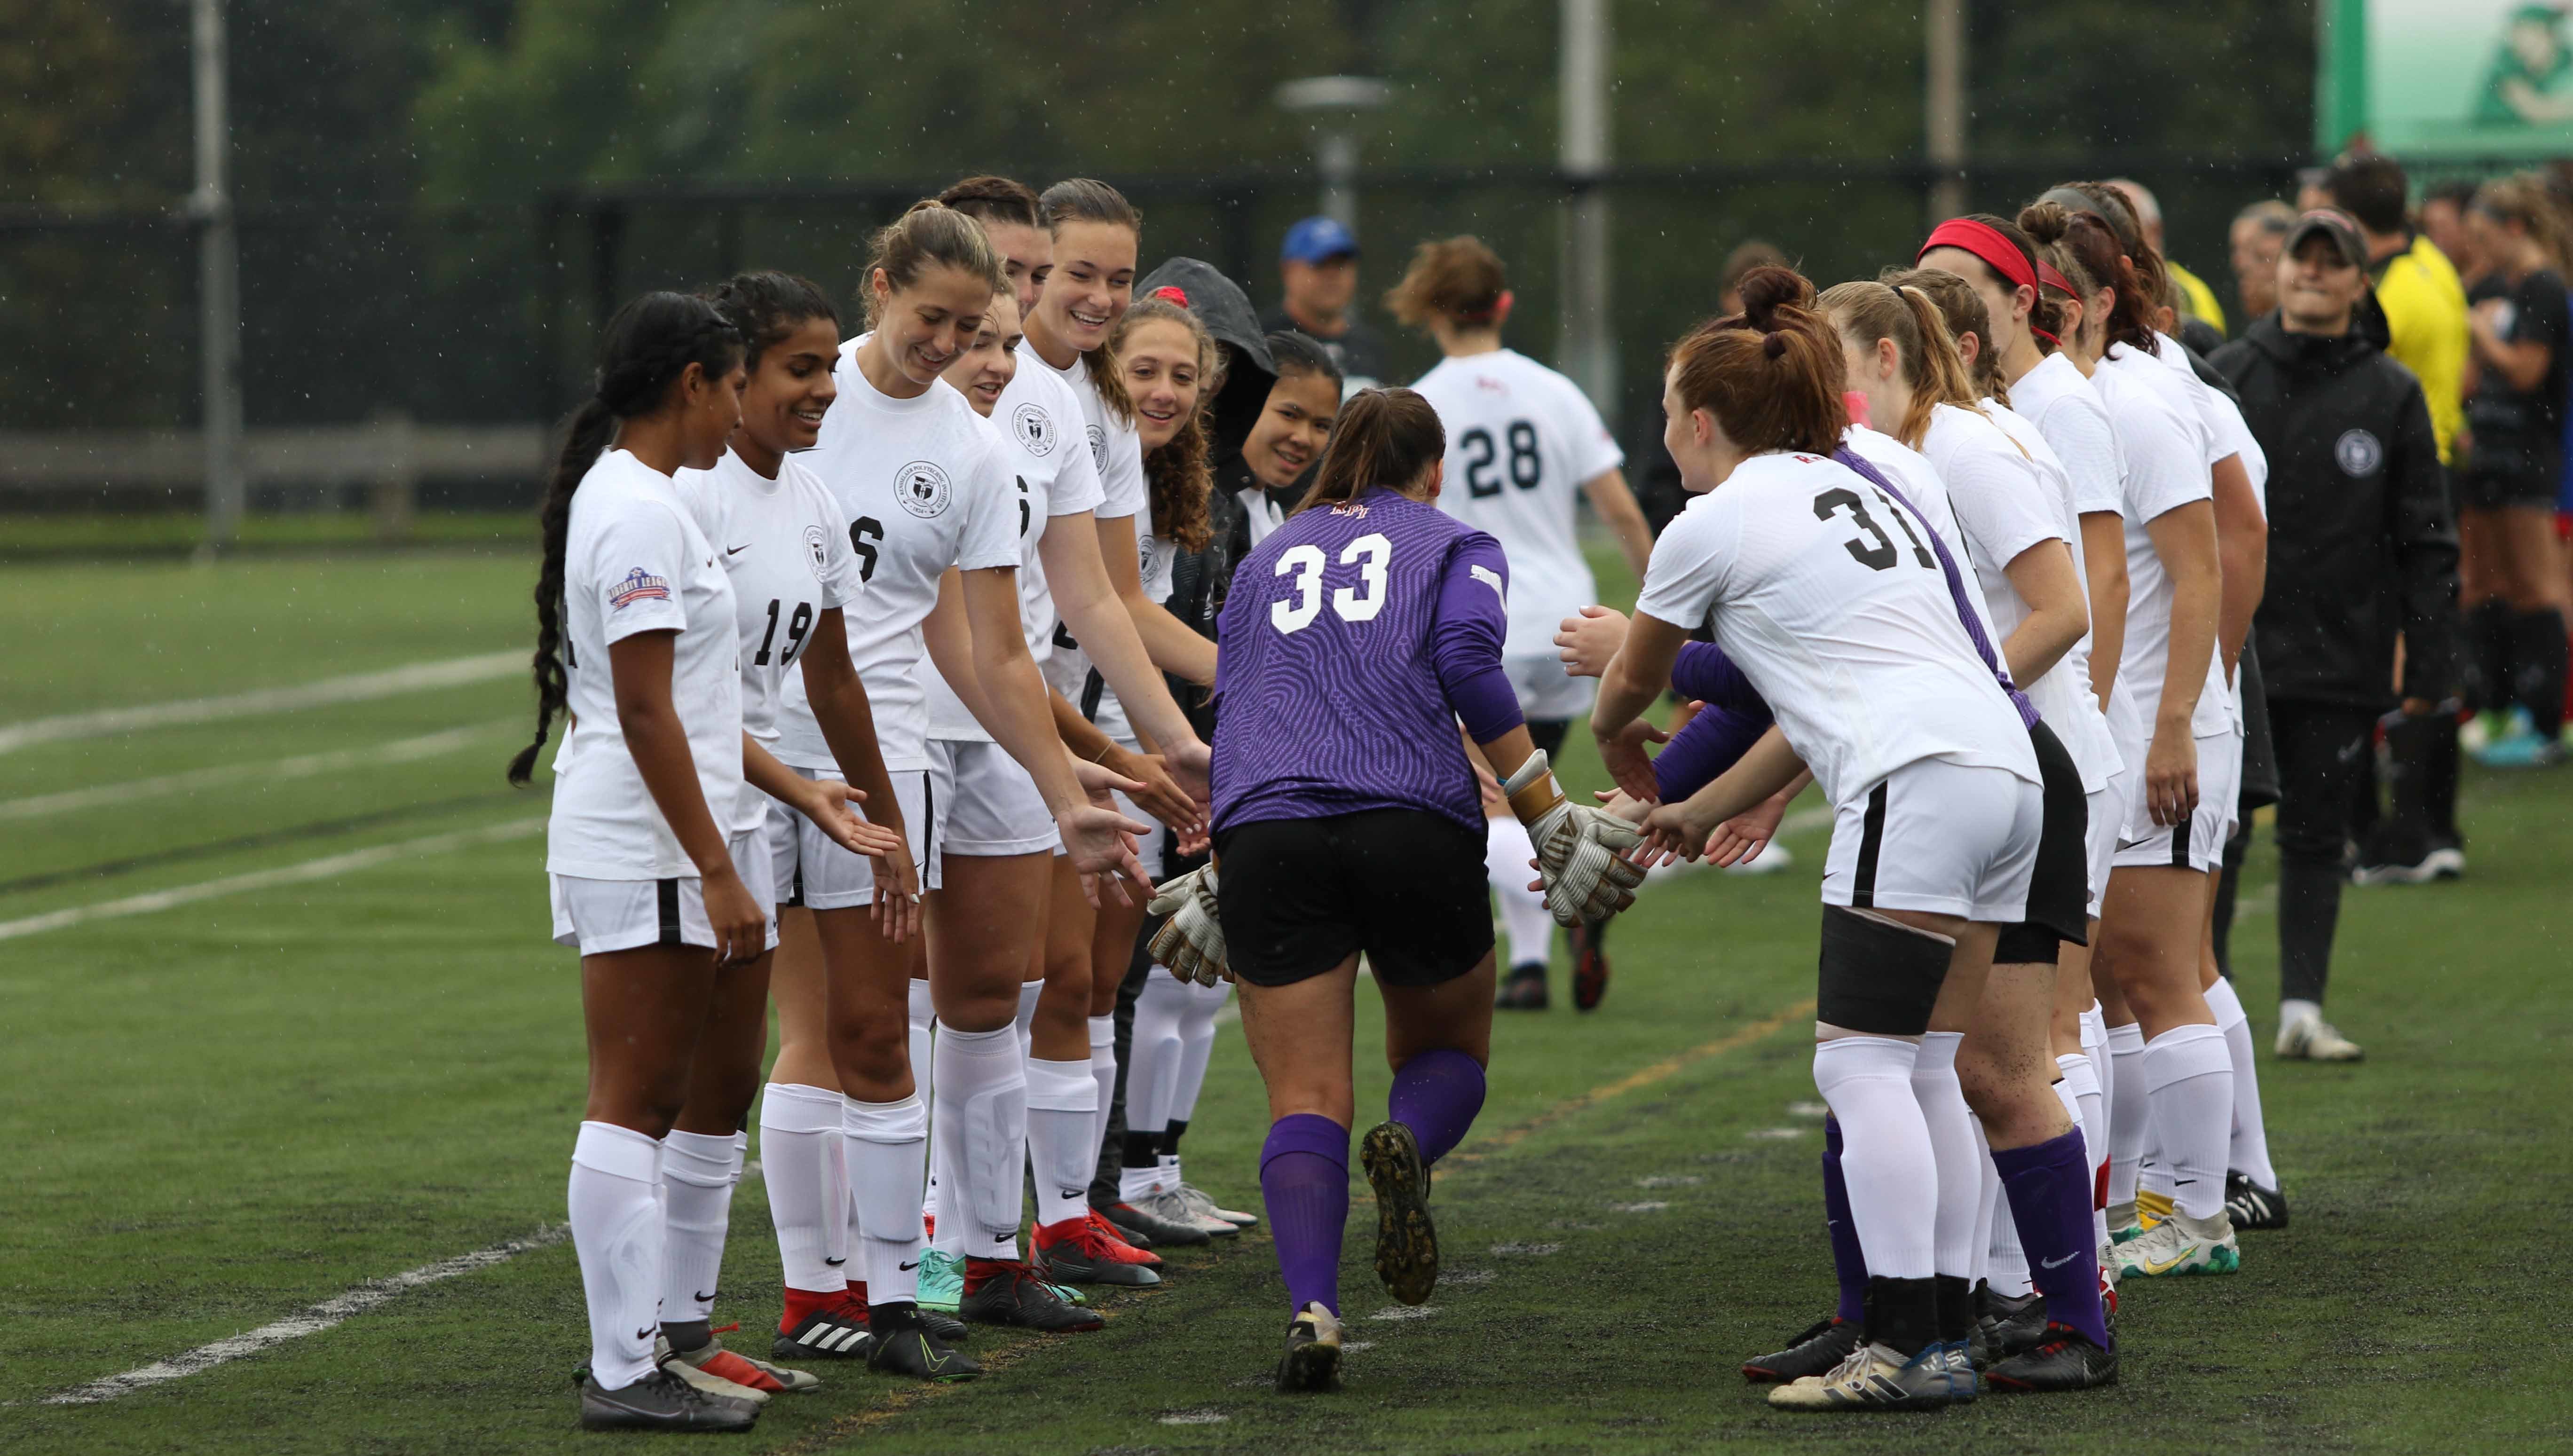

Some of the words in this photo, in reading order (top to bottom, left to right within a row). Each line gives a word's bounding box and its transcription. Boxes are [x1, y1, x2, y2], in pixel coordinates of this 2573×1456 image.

[1460, 420, 1540, 498] 28
[936, 484, 947, 508] INSTITUTE
[1330, 501, 1369, 519] RPI
[1813, 487, 1936, 571] 31
[1271, 533, 1392, 634] 33
[754, 598, 812, 665] 19
